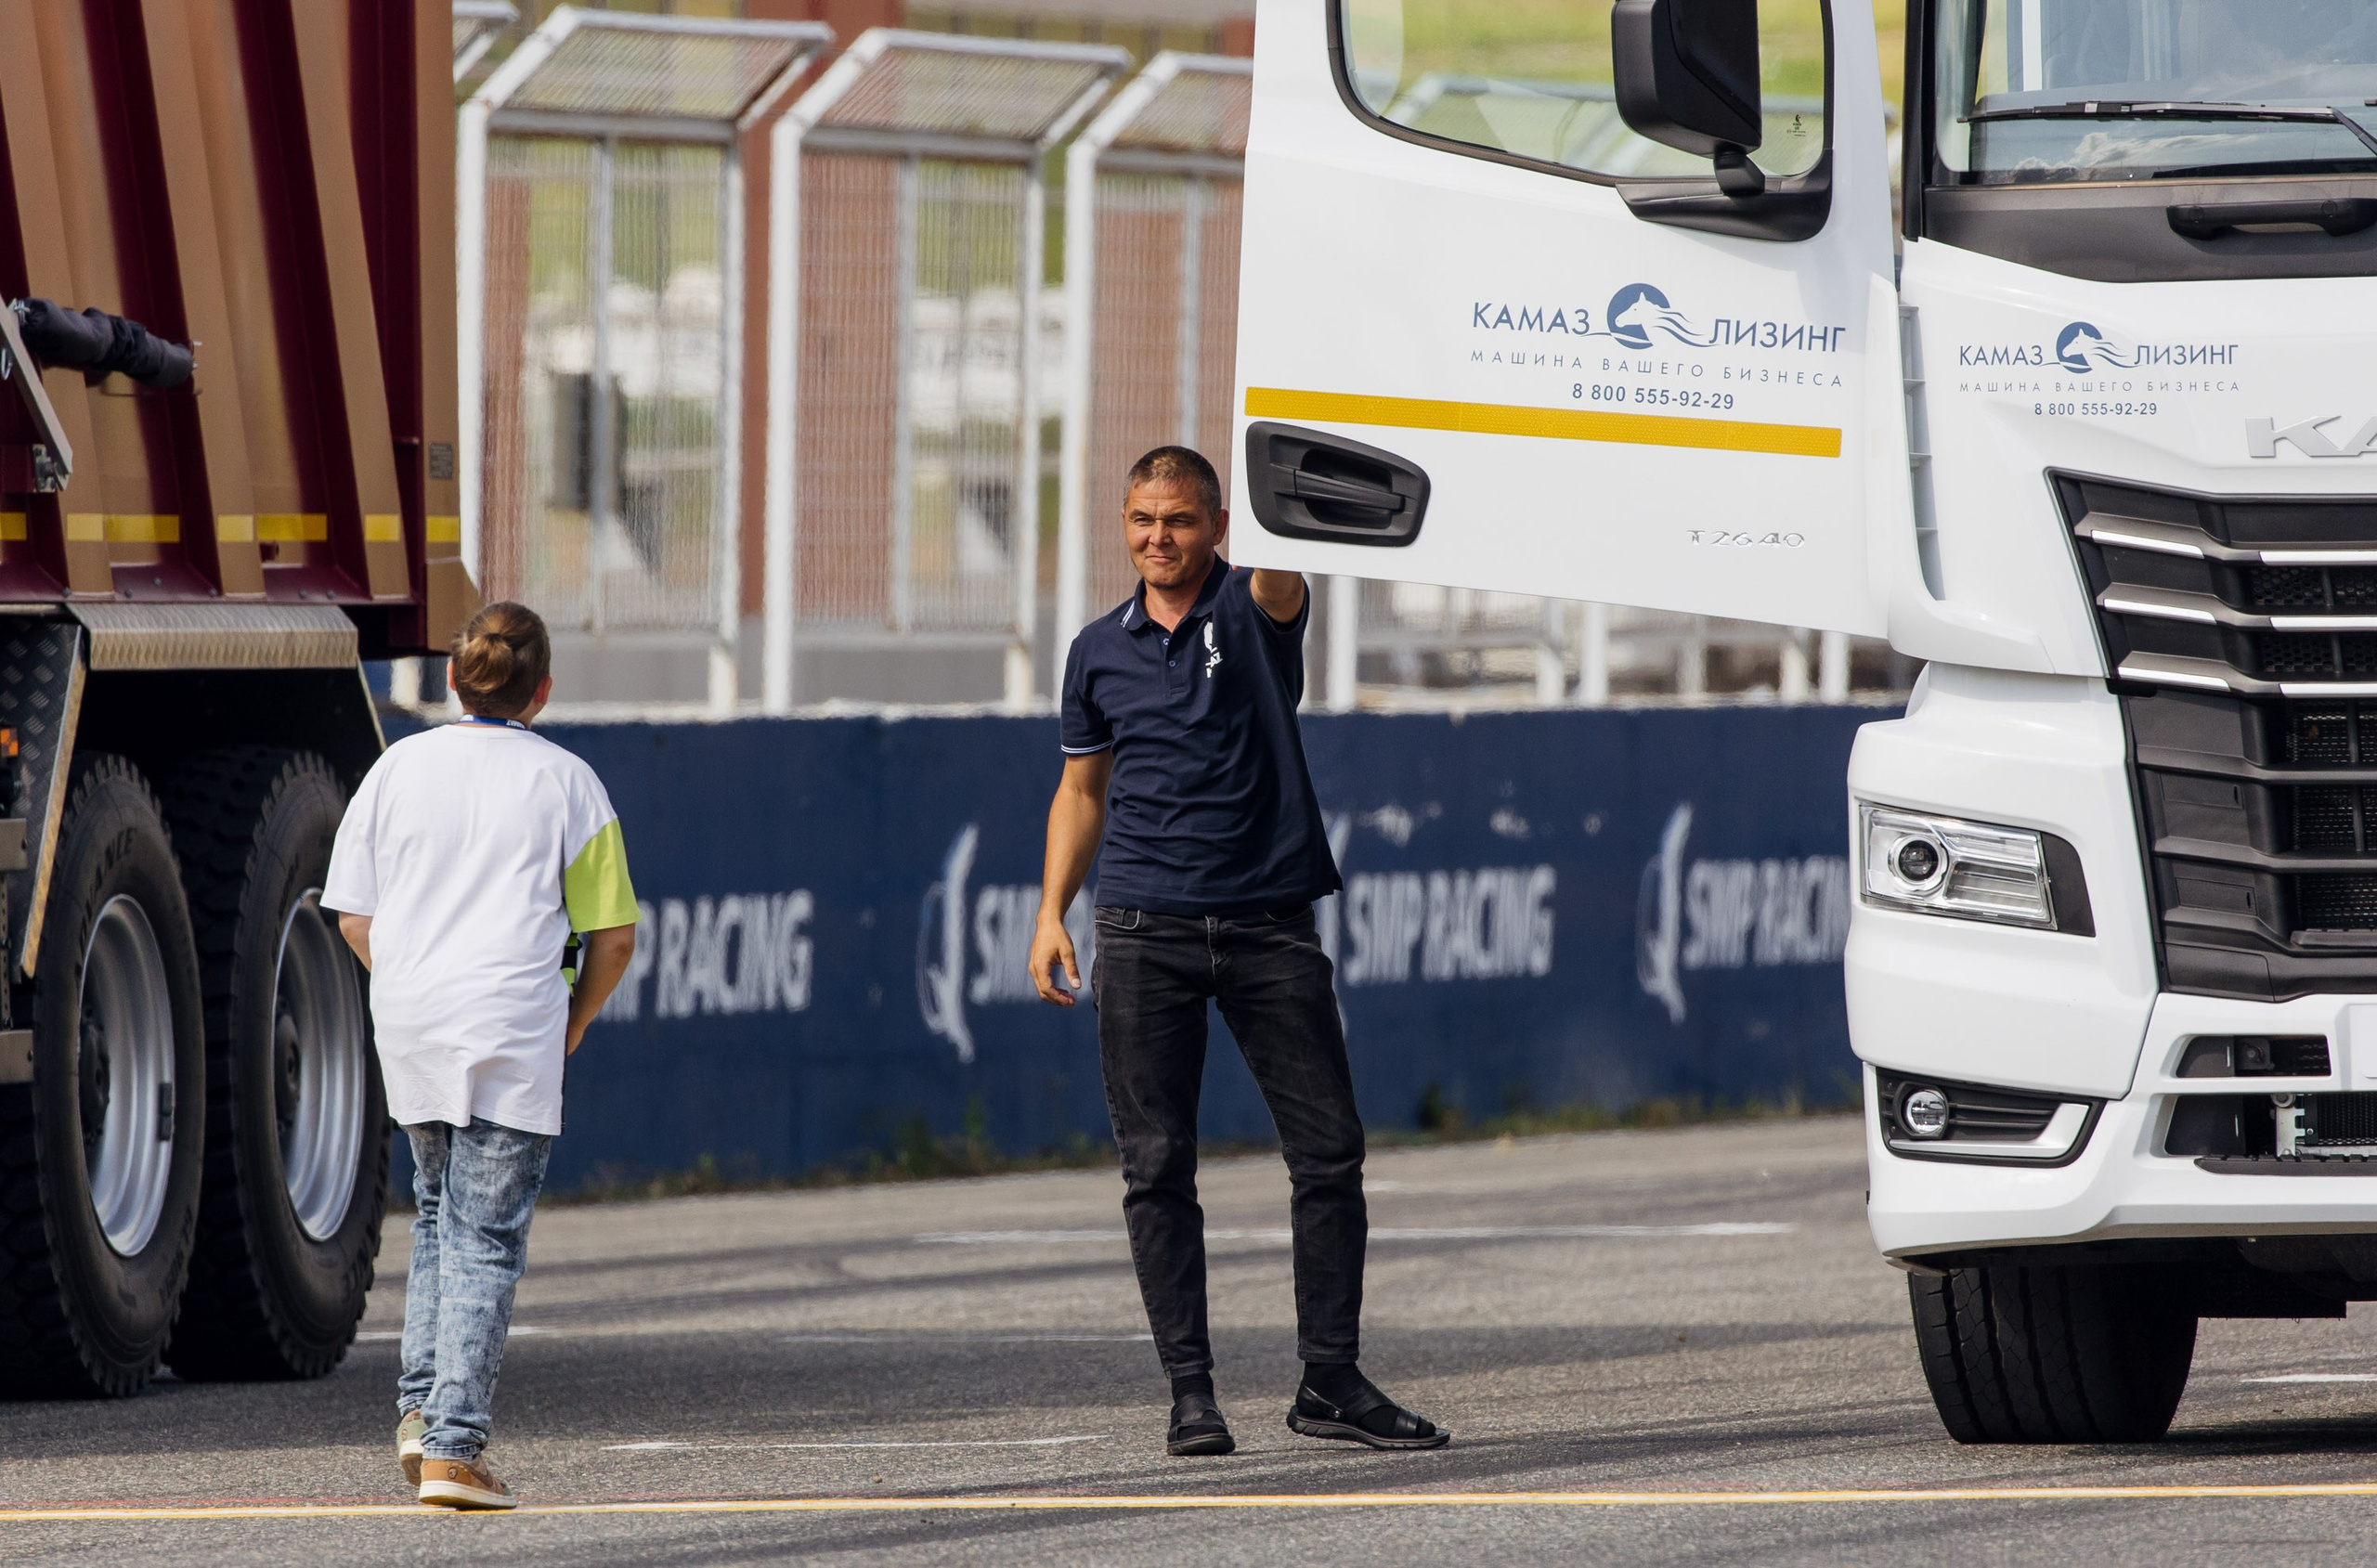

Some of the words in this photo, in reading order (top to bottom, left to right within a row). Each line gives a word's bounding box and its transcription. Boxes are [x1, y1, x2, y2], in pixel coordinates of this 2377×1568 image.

[1473, 302, 1591, 335] КАМАЗ
[1708, 317, 1846, 353] ЛИЗИНГ
[1471, 350, 1582, 369] МАШИНА
[1603, 357, 1704, 378] ВАШЕГО
[1724, 366, 1842, 387] БИЗНЕСА
[1959, 344, 2043, 366] КАМАЗ
[2135, 344, 2239, 366] ЛИЗИНГ
[1572, 382, 1583, 399] 8
[1591, 383, 1626, 402] 800
[1634, 387, 1734, 410] 555-92-29
[1959, 382, 2041, 393] МАШИНА
[2055, 381, 2133, 393] ВАШЕГО
[2147, 381, 2240, 392] БИЗНЕСА
[2033, 402, 2043, 416] 8
[2048, 402, 2075, 416] 800
[2081, 402, 2157, 416] 555-92-29
[1422, 863, 1557, 980] RACING
[1753, 855, 1851, 965] RACIN
[656, 888, 813, 1017] RACING
